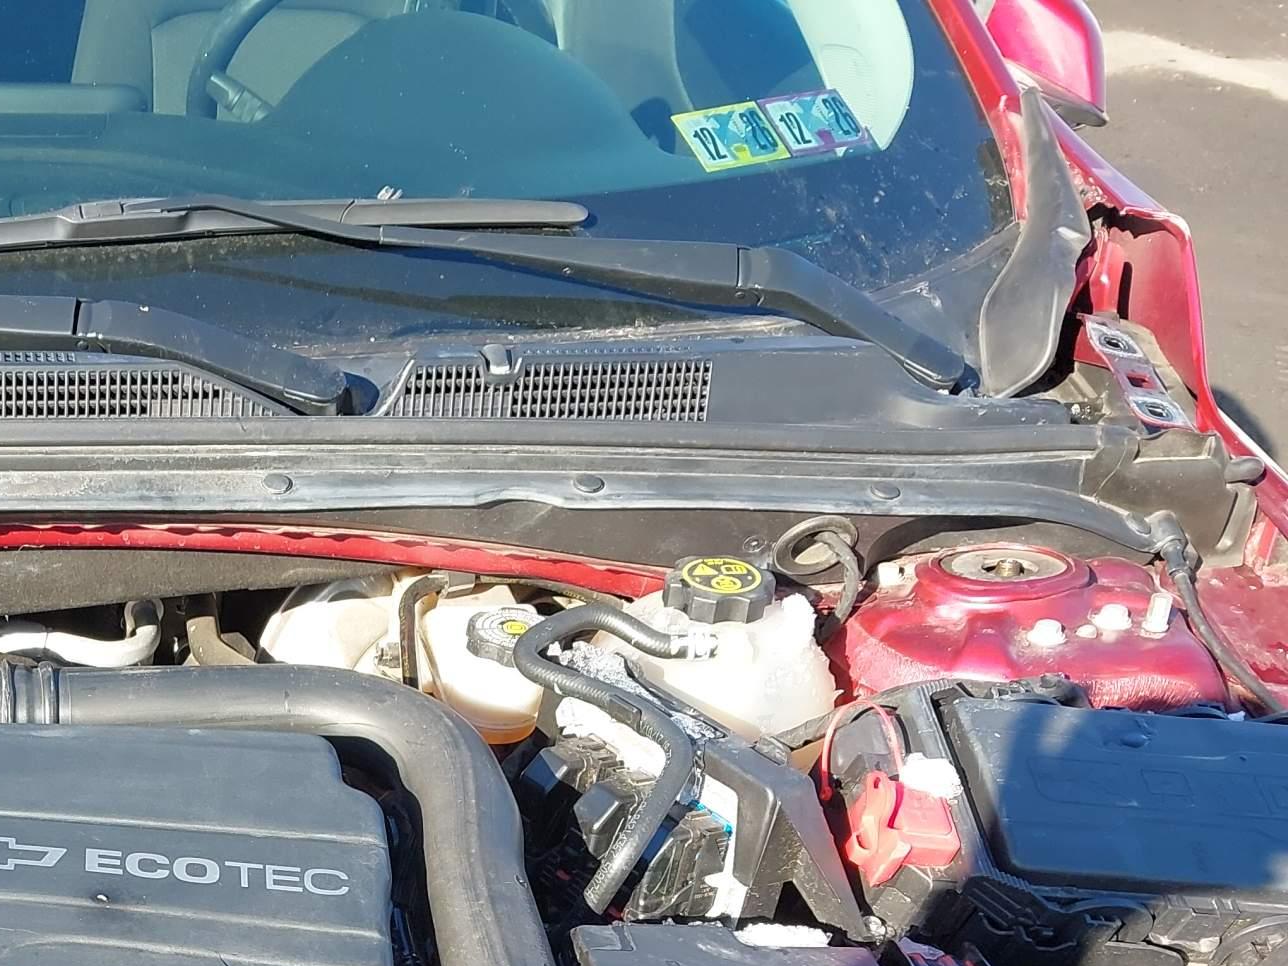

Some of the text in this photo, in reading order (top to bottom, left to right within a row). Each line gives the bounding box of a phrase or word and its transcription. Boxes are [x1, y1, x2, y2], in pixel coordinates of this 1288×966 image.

[693, 127, 728, 160] 12
[779, 96, 861, 144] 12 26
[85, 848, 350, 896] ECOTEC
